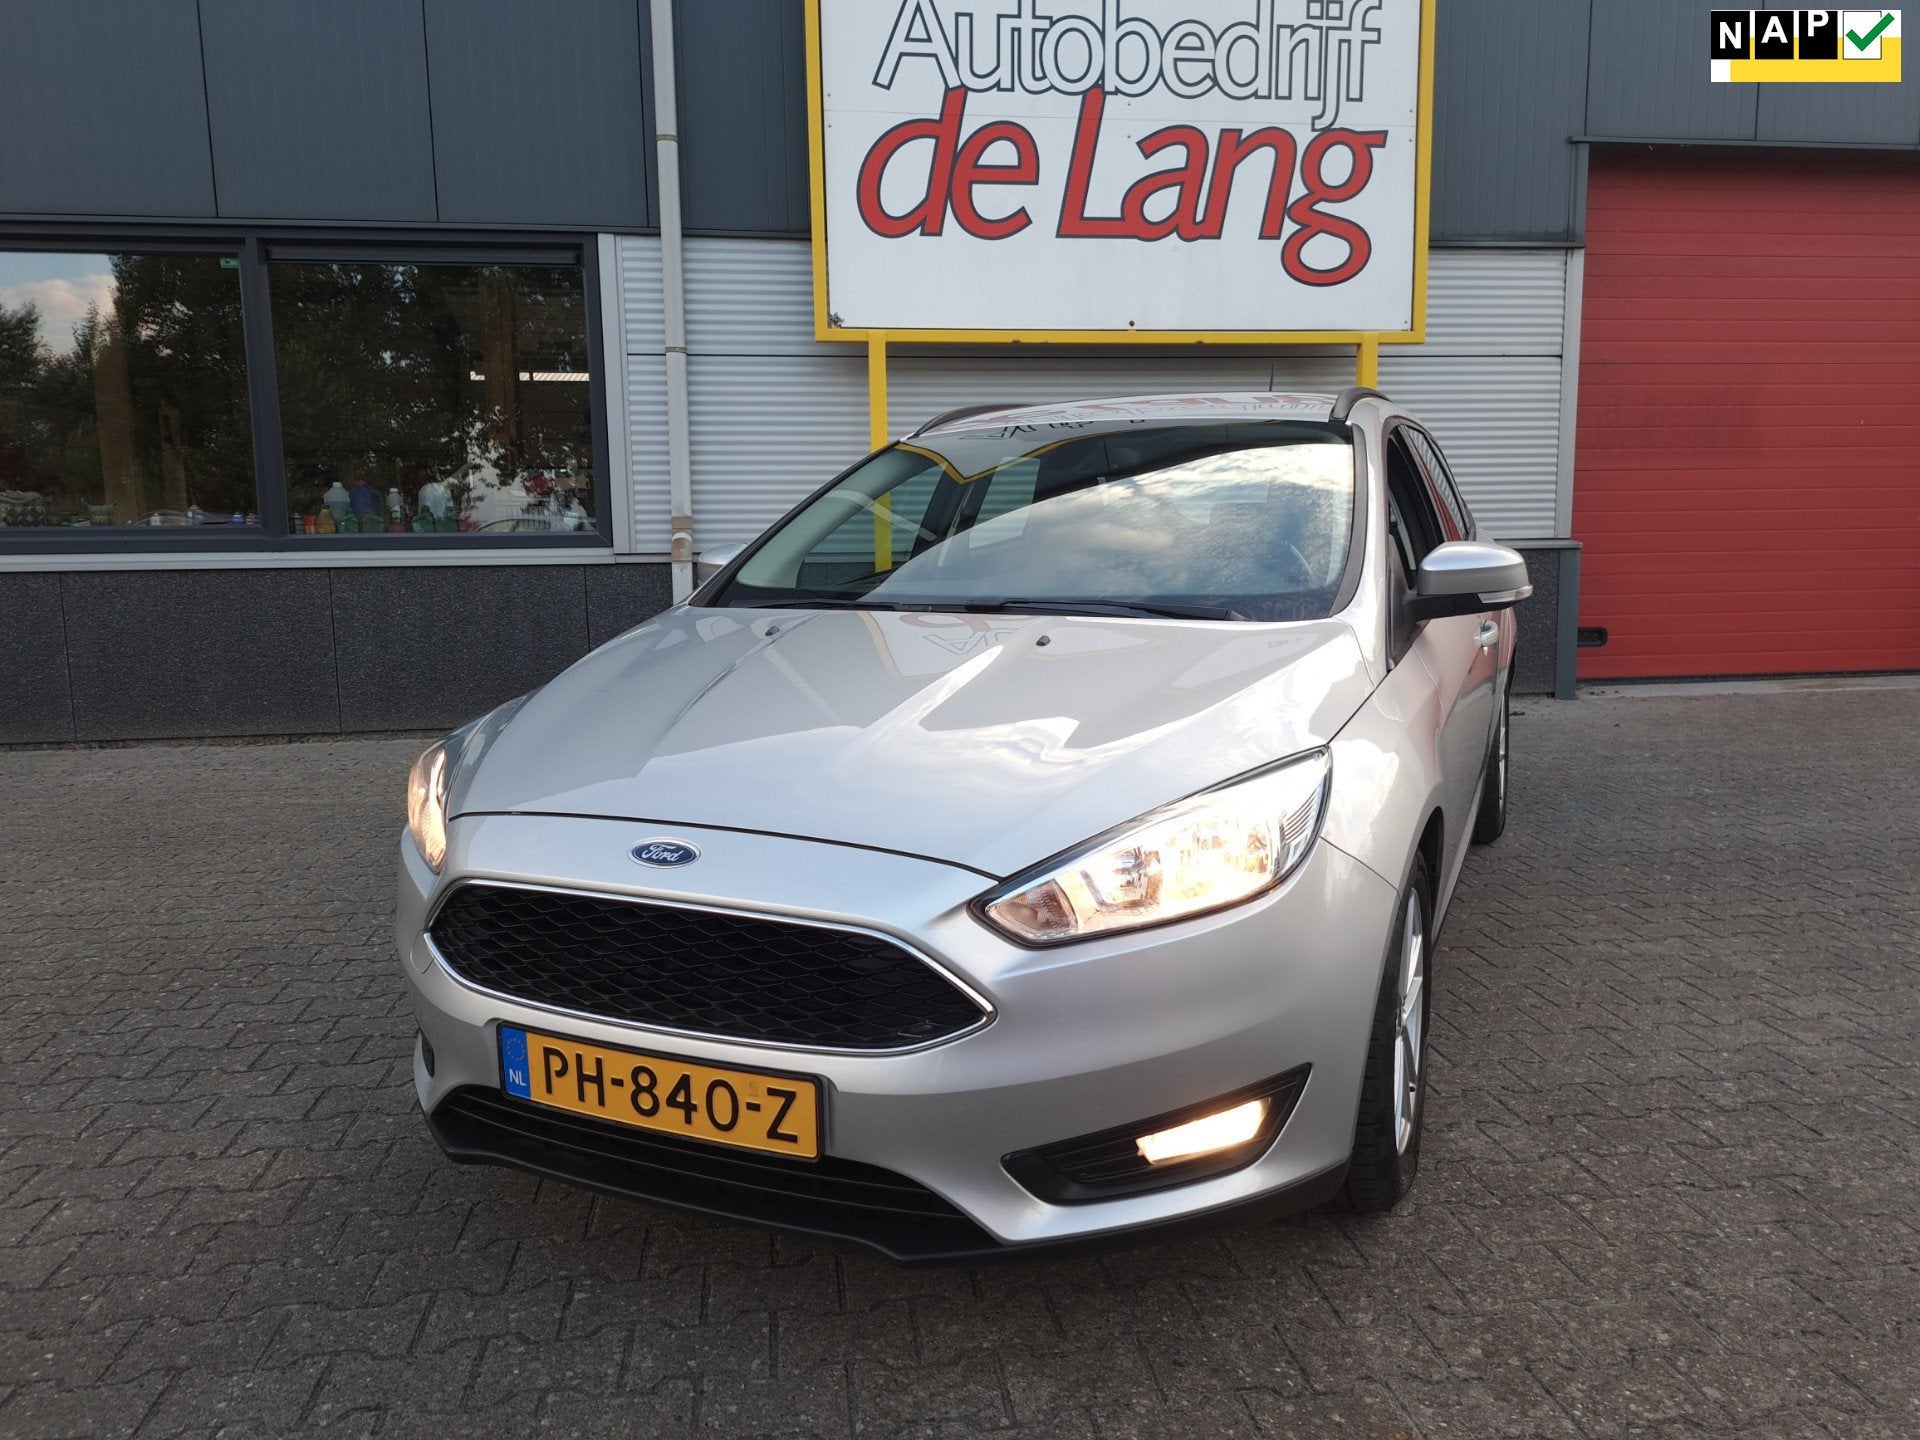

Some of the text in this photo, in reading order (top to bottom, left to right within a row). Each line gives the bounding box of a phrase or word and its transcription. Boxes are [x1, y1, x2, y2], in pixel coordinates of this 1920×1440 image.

[872, 0, 1382, 132] Autobedrijf
[856, 86, 1389, 288] de Lang
[641, 844, 685, 862] Ford
[508, 1068, 527, 1087] NL
[542, 1045, 799, 1144] PH-840-Z
